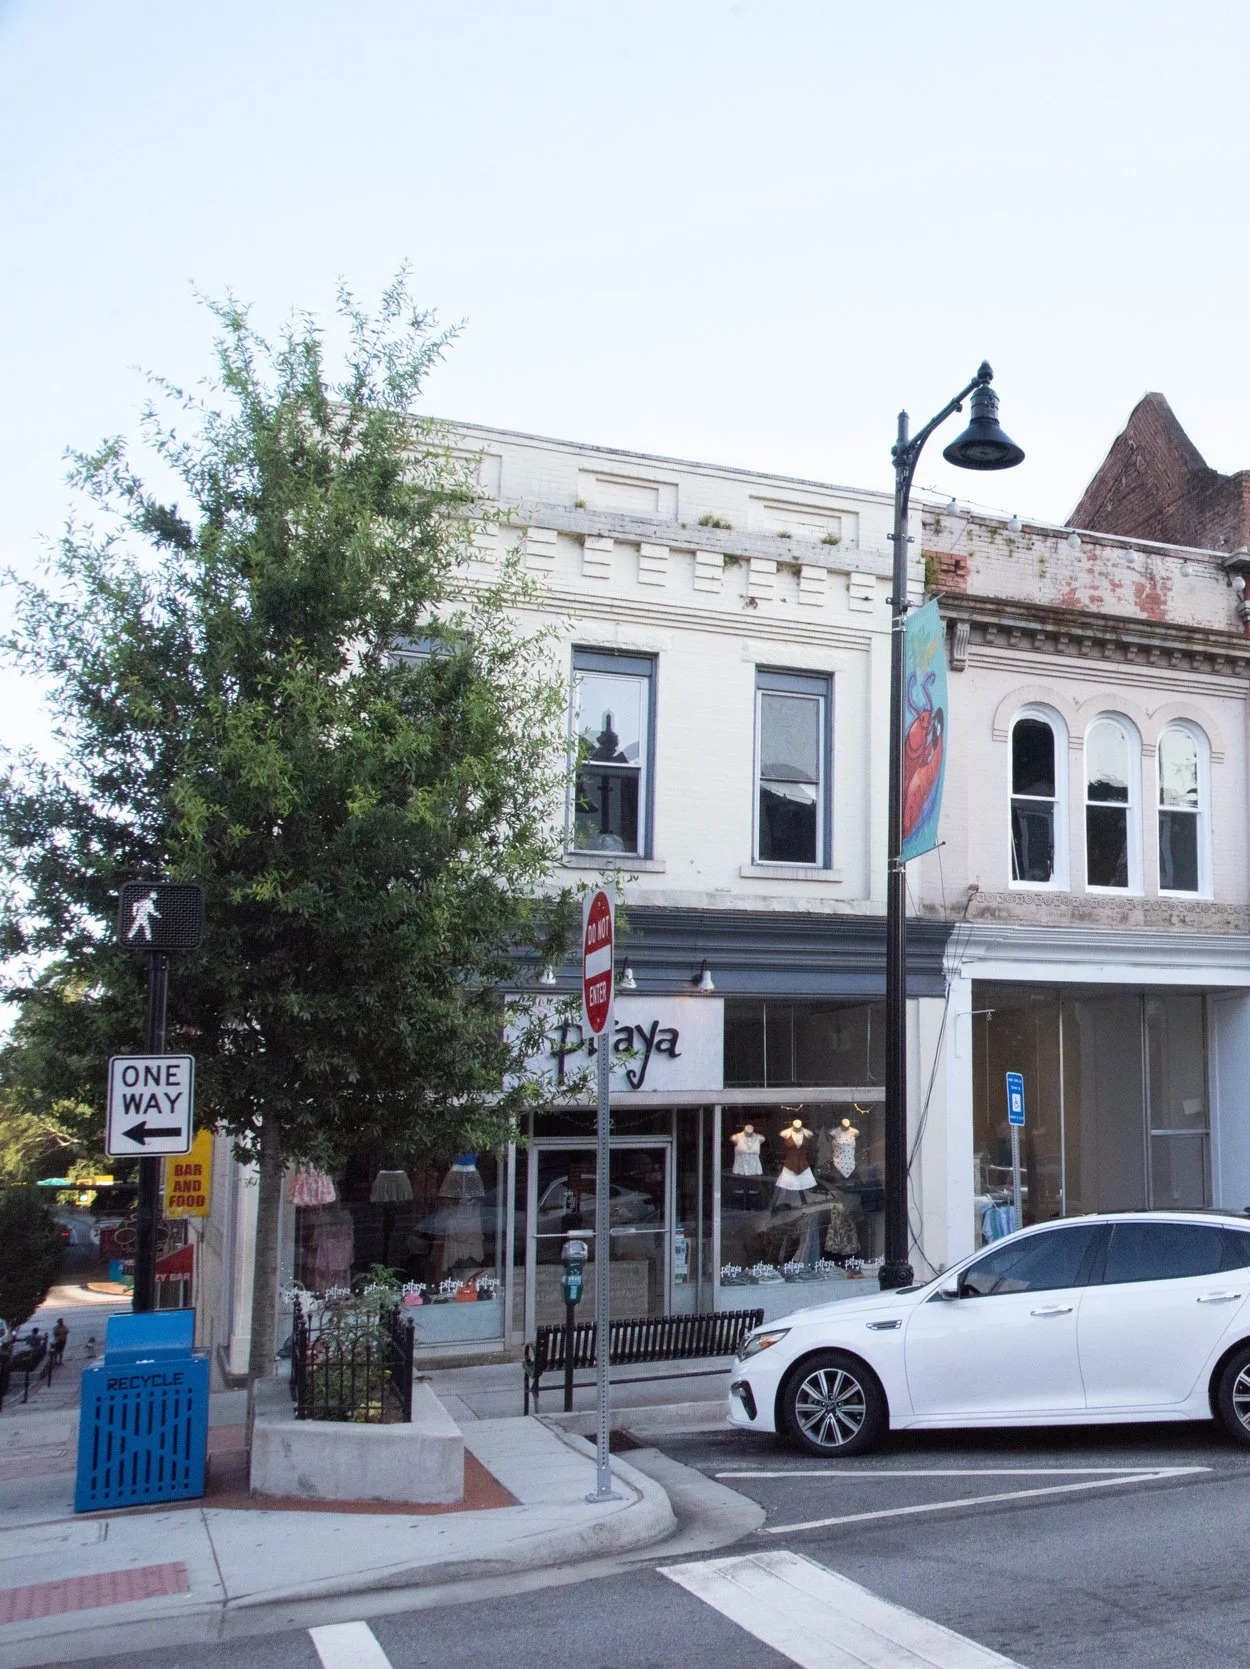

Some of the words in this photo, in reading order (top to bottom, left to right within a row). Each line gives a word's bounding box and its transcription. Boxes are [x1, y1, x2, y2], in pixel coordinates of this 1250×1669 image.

[588, 922, 597, 946] DO
[598, 915, 610, 941] NOT
[589, 981, 607, 1007] ENTER
[551, 1017, 682, 1090] piaya
[122, 1065, 182, 1088] ONE
[122, 1092, 183, 1115] WAY
[593, 1118, 616, 1129] 22
[174, 1164, 203, 1177] BAR
[173, 1179, 202, 1193] AND
[169, 1195, 206, 1208] FOOD
[170, 1272, 191, 1281] BAR
[107, 1373, 184, 1391] RECYCLE
